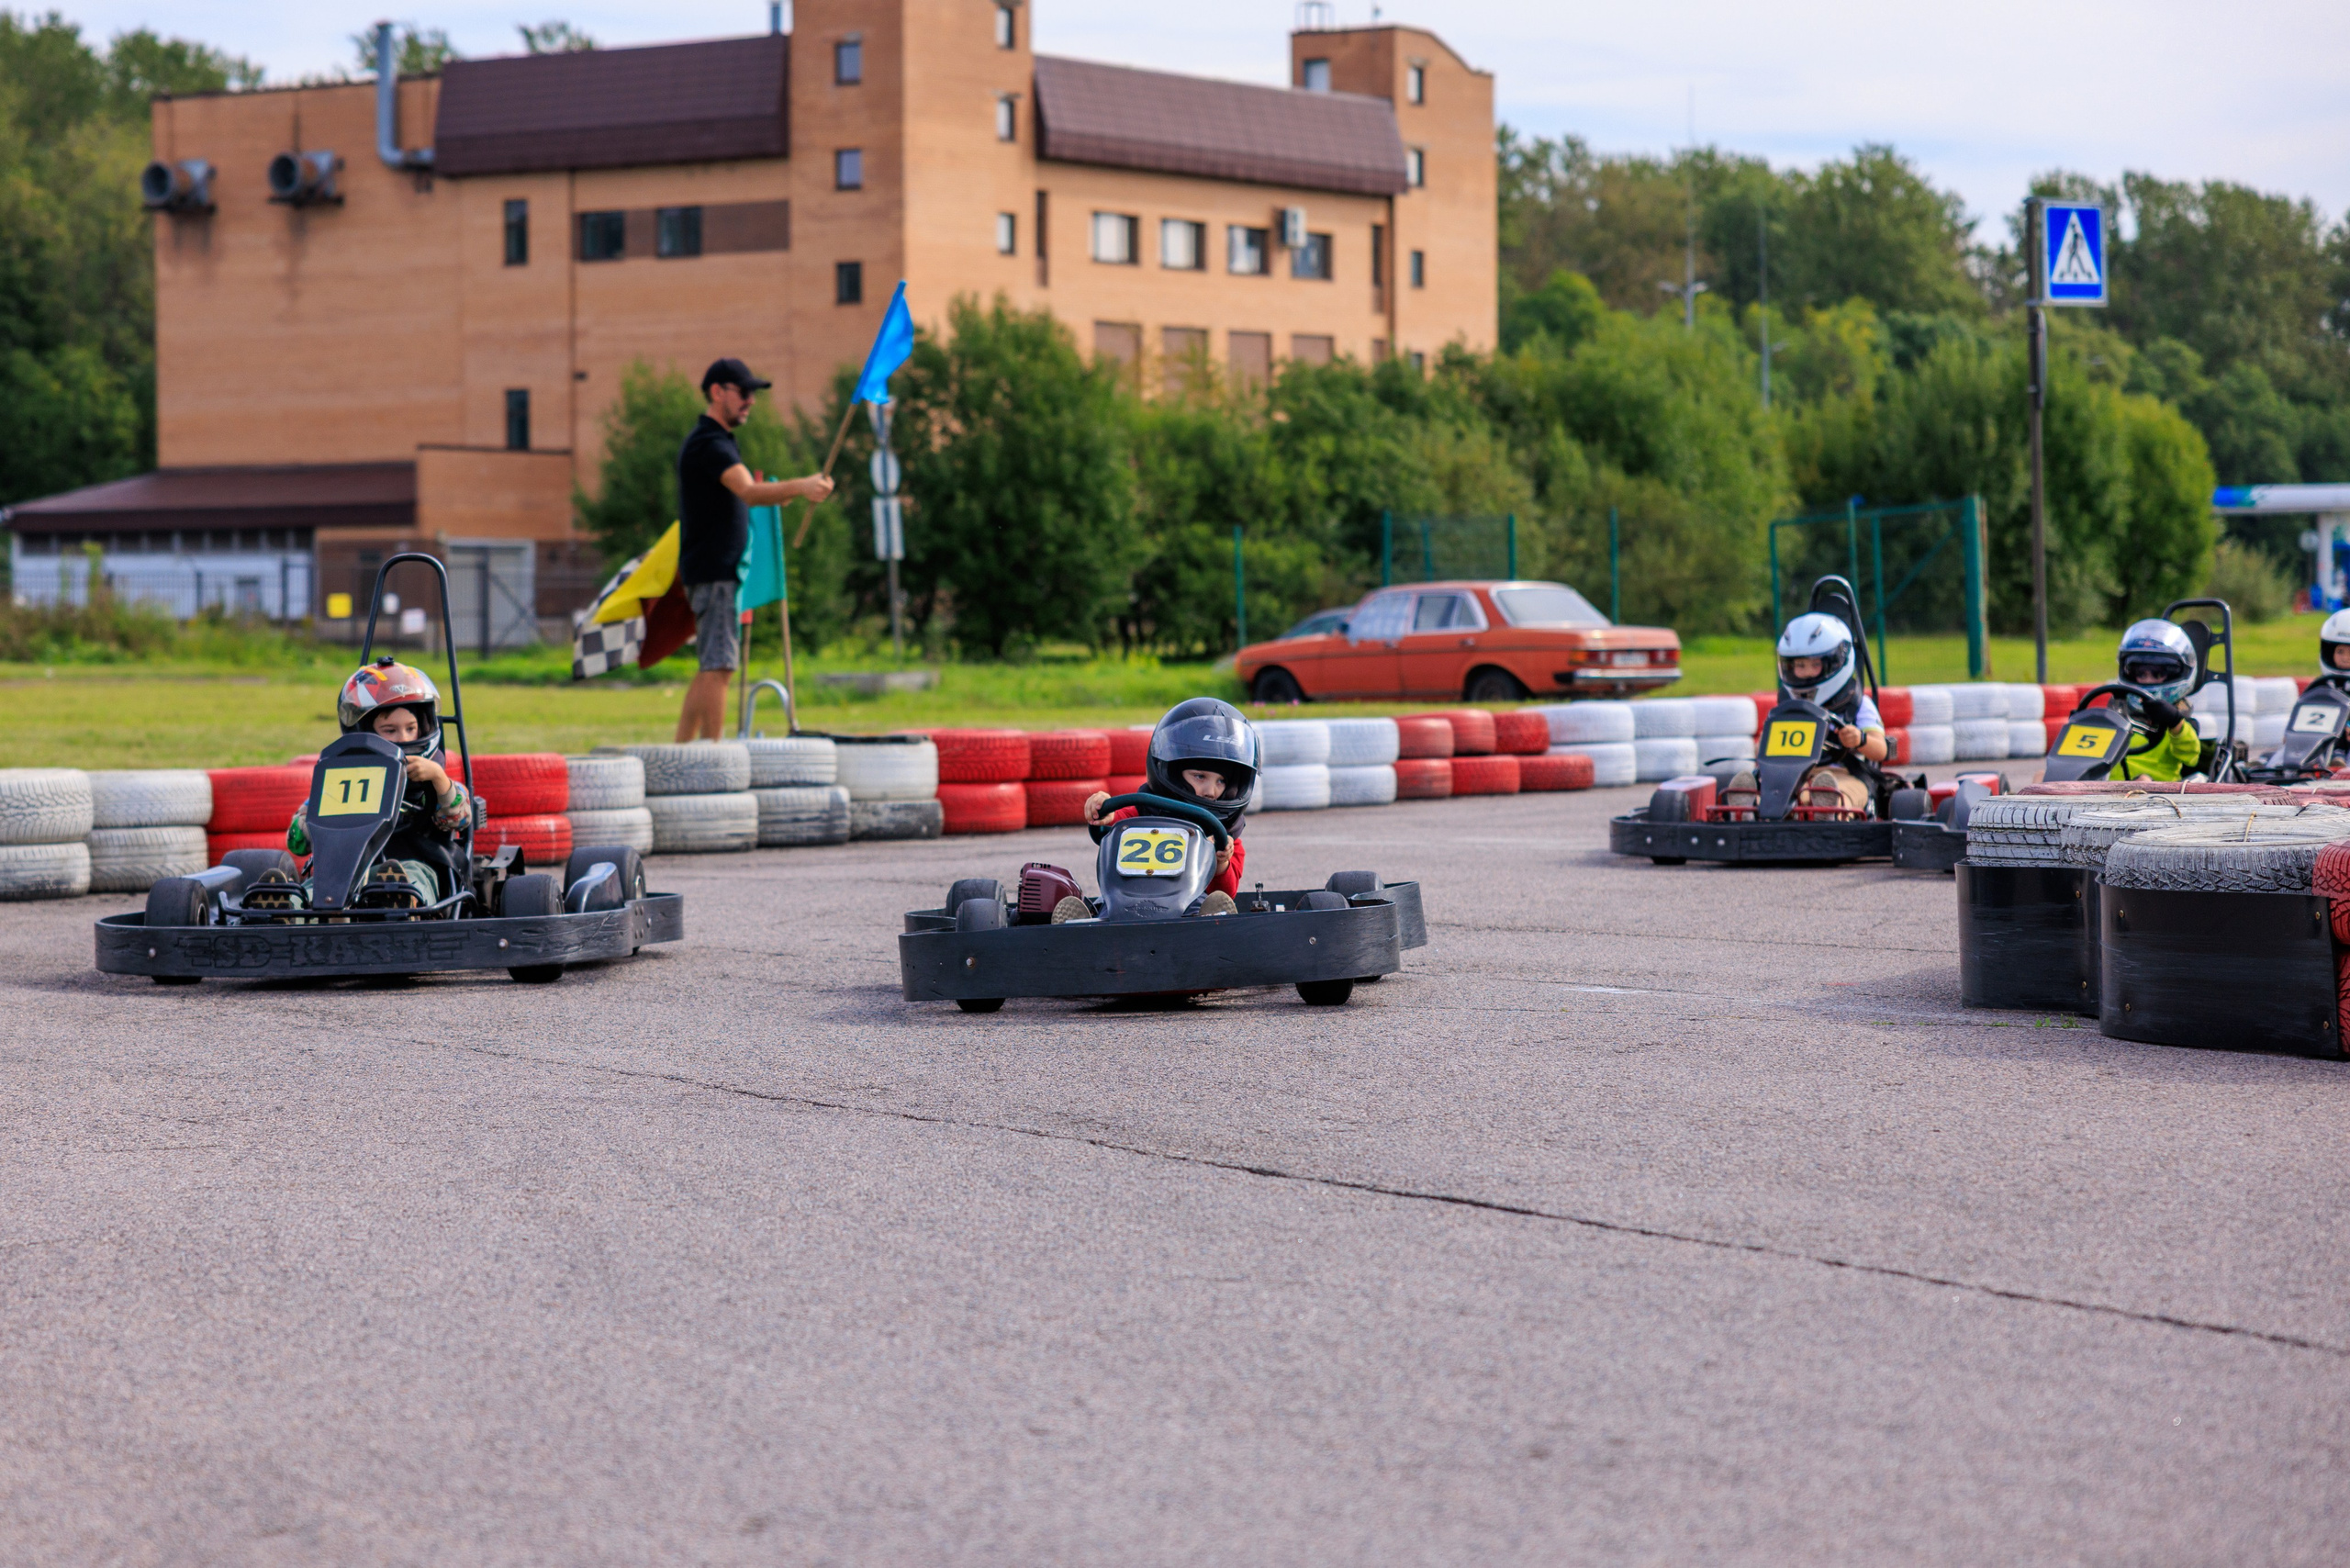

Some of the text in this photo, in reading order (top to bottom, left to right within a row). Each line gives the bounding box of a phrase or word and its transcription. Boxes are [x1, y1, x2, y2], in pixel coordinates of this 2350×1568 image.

[2307, 711, 2326, 726] 2
[1779, 730, 1806, 747] 10
[2076, 734, 2099, 749] 5
[339, 778, 370, 803] 11
[1120, 838, 1184, 864] 26
